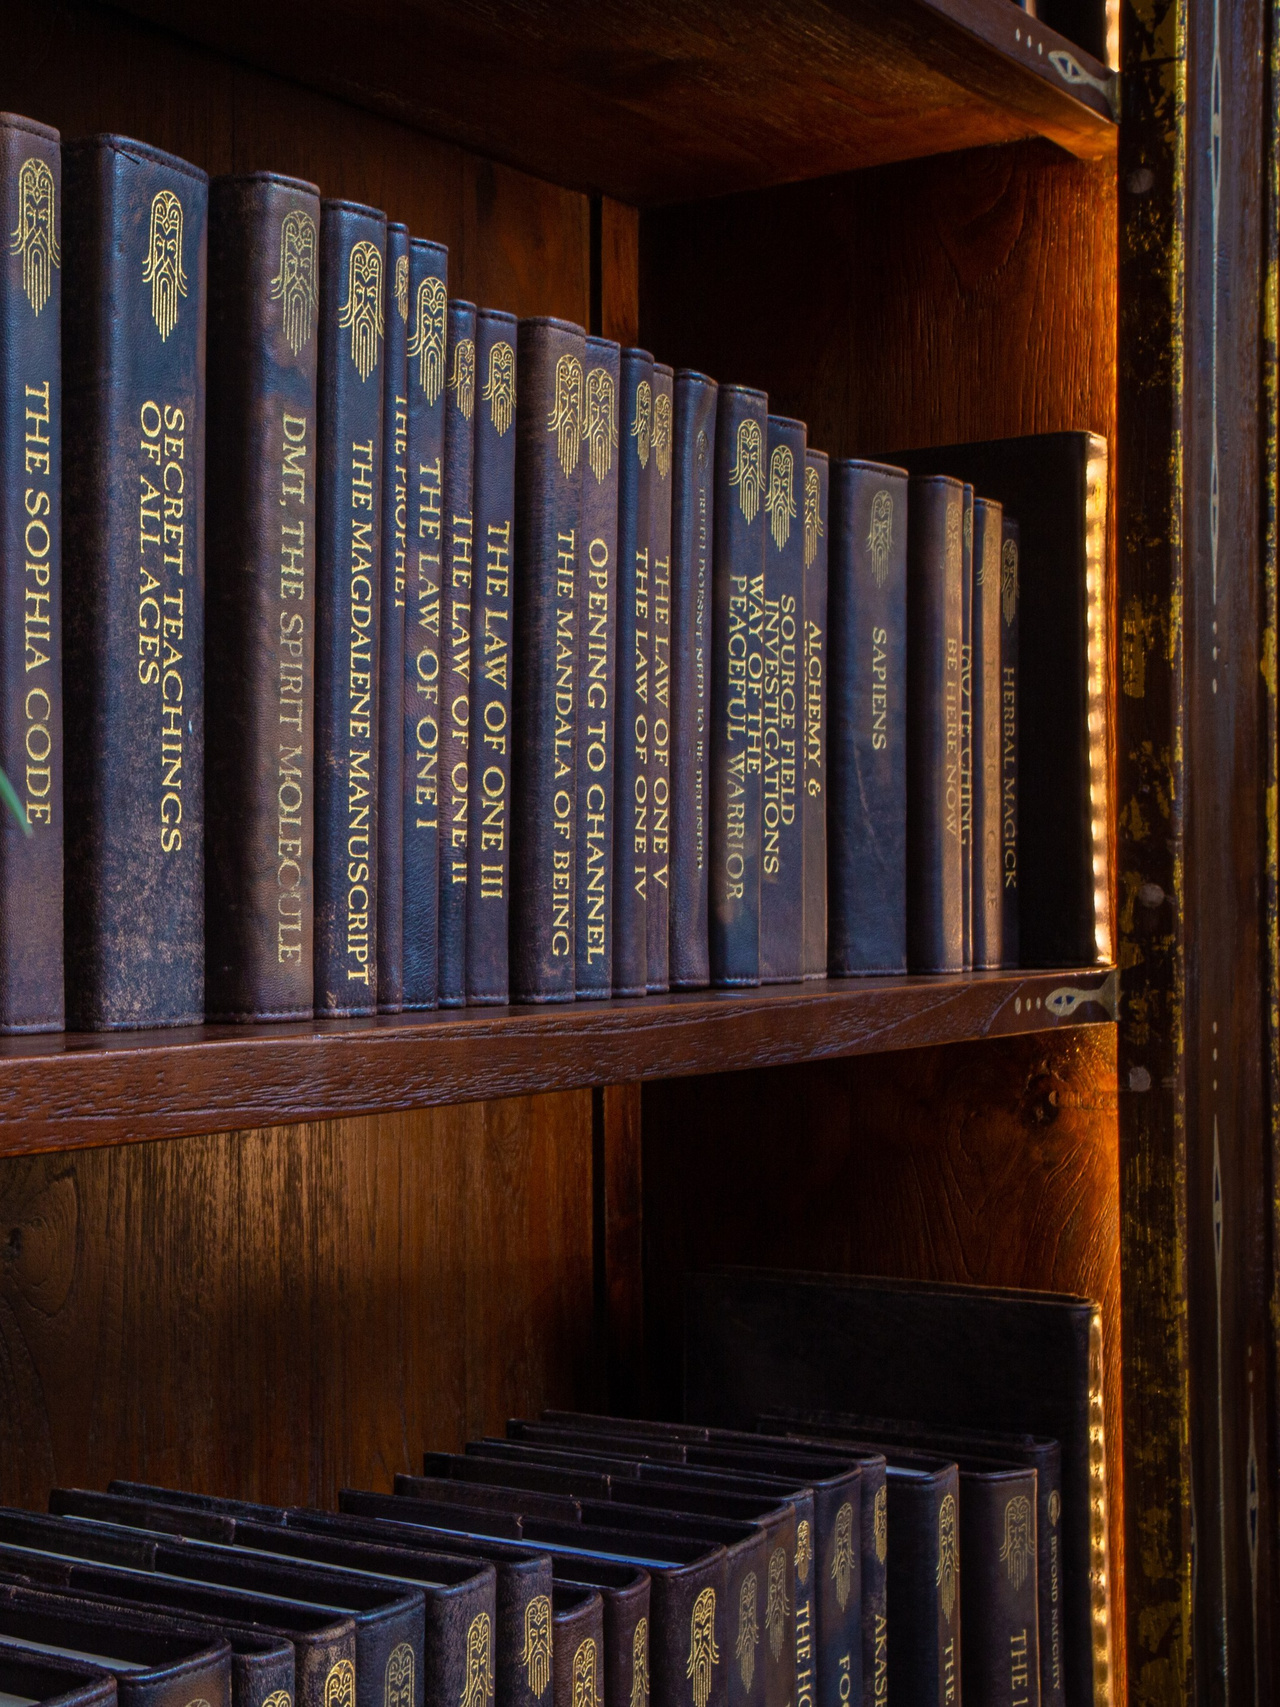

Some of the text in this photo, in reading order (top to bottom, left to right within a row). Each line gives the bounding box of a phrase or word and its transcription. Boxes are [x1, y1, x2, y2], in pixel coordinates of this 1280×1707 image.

[25, 382, 51, 823] THE SOPHIA CODE
[139, 401, 161, 684] OF ALL AGES
[159, 405, 185, 852] SECRET TEACHINGS
[395, 395, 407, 608] THE PROPHET
[278, 413, 306, 966] DMT, THE SPIRIT MOLECULE
[348, 440, 373, 985] THE MAGDALENE MANUSCRIPT
[416, 457, 441, 828] THE LAW OF ONE I
[452, 511, 473, 883] THE LAW OF ONE II
[481, 521, 510, 898] THE LAW OF ONE III
[553, 530, 574, 956] THE MANDALA OF BEING
[587, 538, 608, 964] OPENING TO CHANNEL
[635, 548, 648, 900] THE LAW OF ONE IV
[653, 556, 669, 888] THE LAW OF ONE V
[696, 708, 704, 733] TO
[696, 740, 704, 762] BE
[725, 575, 747, 900] PEACEFUL WARRIOR
[746, 573, 763, 774] WAY OF THE
[763, 599, 780, 874] INVESTIGATIONS
[779, 594, 796, 825] SOURCE FIELD
[808, 621, 822, 798] ALCHEMY &
[873, 627, 886, 749] SAPIENS
[946, 637, 958, 836] BE HERE NOW
[1004, 667, 1017, 888] HERBAL MAGICK
[797, 1601, 810, 1663] THE
[944, 1637, 954, 1706] THE
[1011, 1629, 1027, 1689] THE
[1050, 1535, 1061, 1690] BEYOND NAUGHTY
